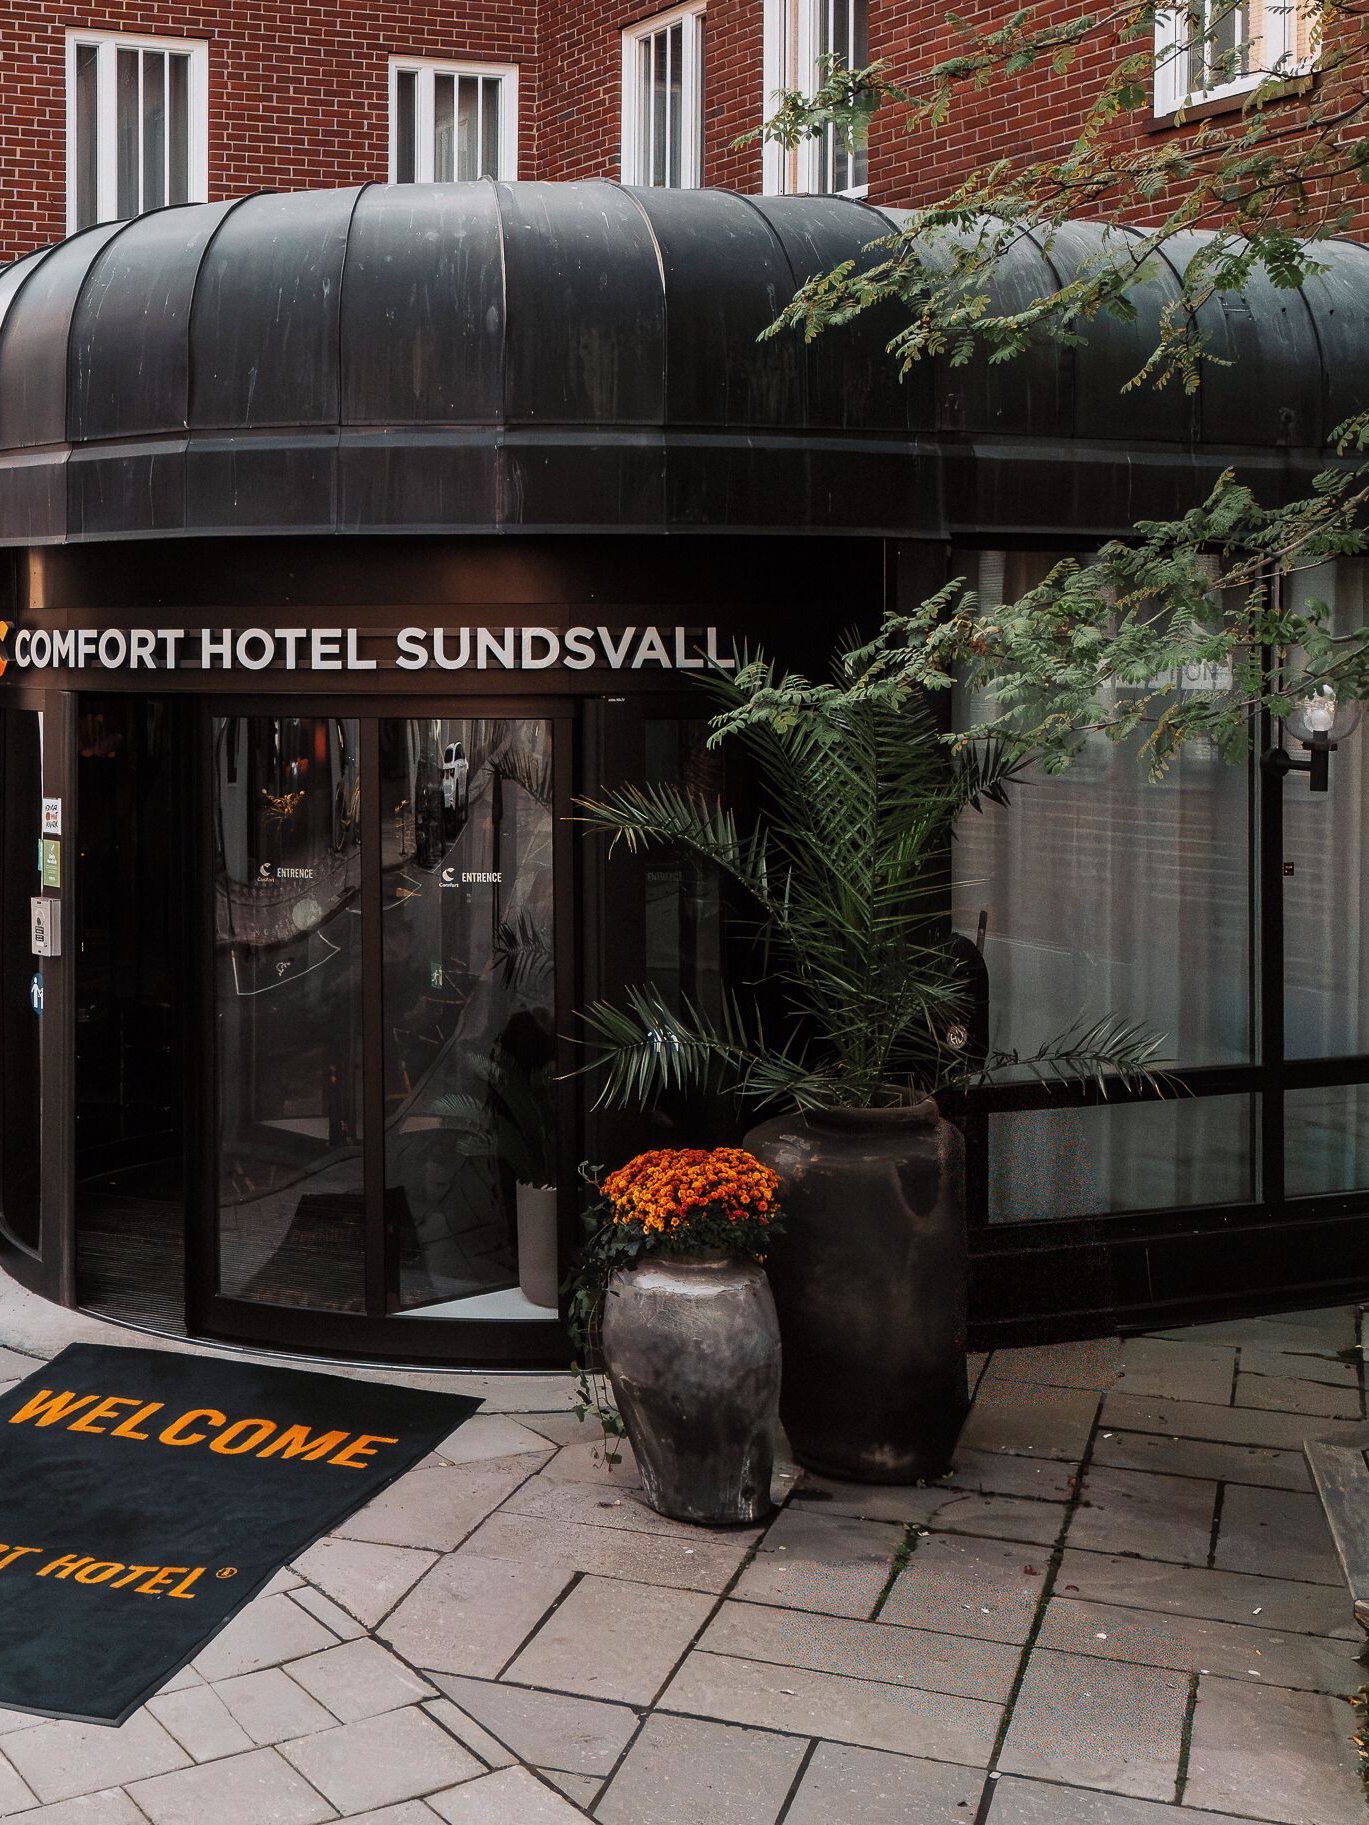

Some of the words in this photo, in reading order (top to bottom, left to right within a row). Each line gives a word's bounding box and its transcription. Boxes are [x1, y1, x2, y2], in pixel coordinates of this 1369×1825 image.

[14, 628, 185, 669] COMFORT
[201, 627, 377, 670] HOTEL
[395, 626, 736, 670] SUNDSVALL
[276, 867, 314, 879] ENTRENCE
[461, 872, 502, 883] ENTRENCE
[8, 1389, 398, 1469] WELCOME
